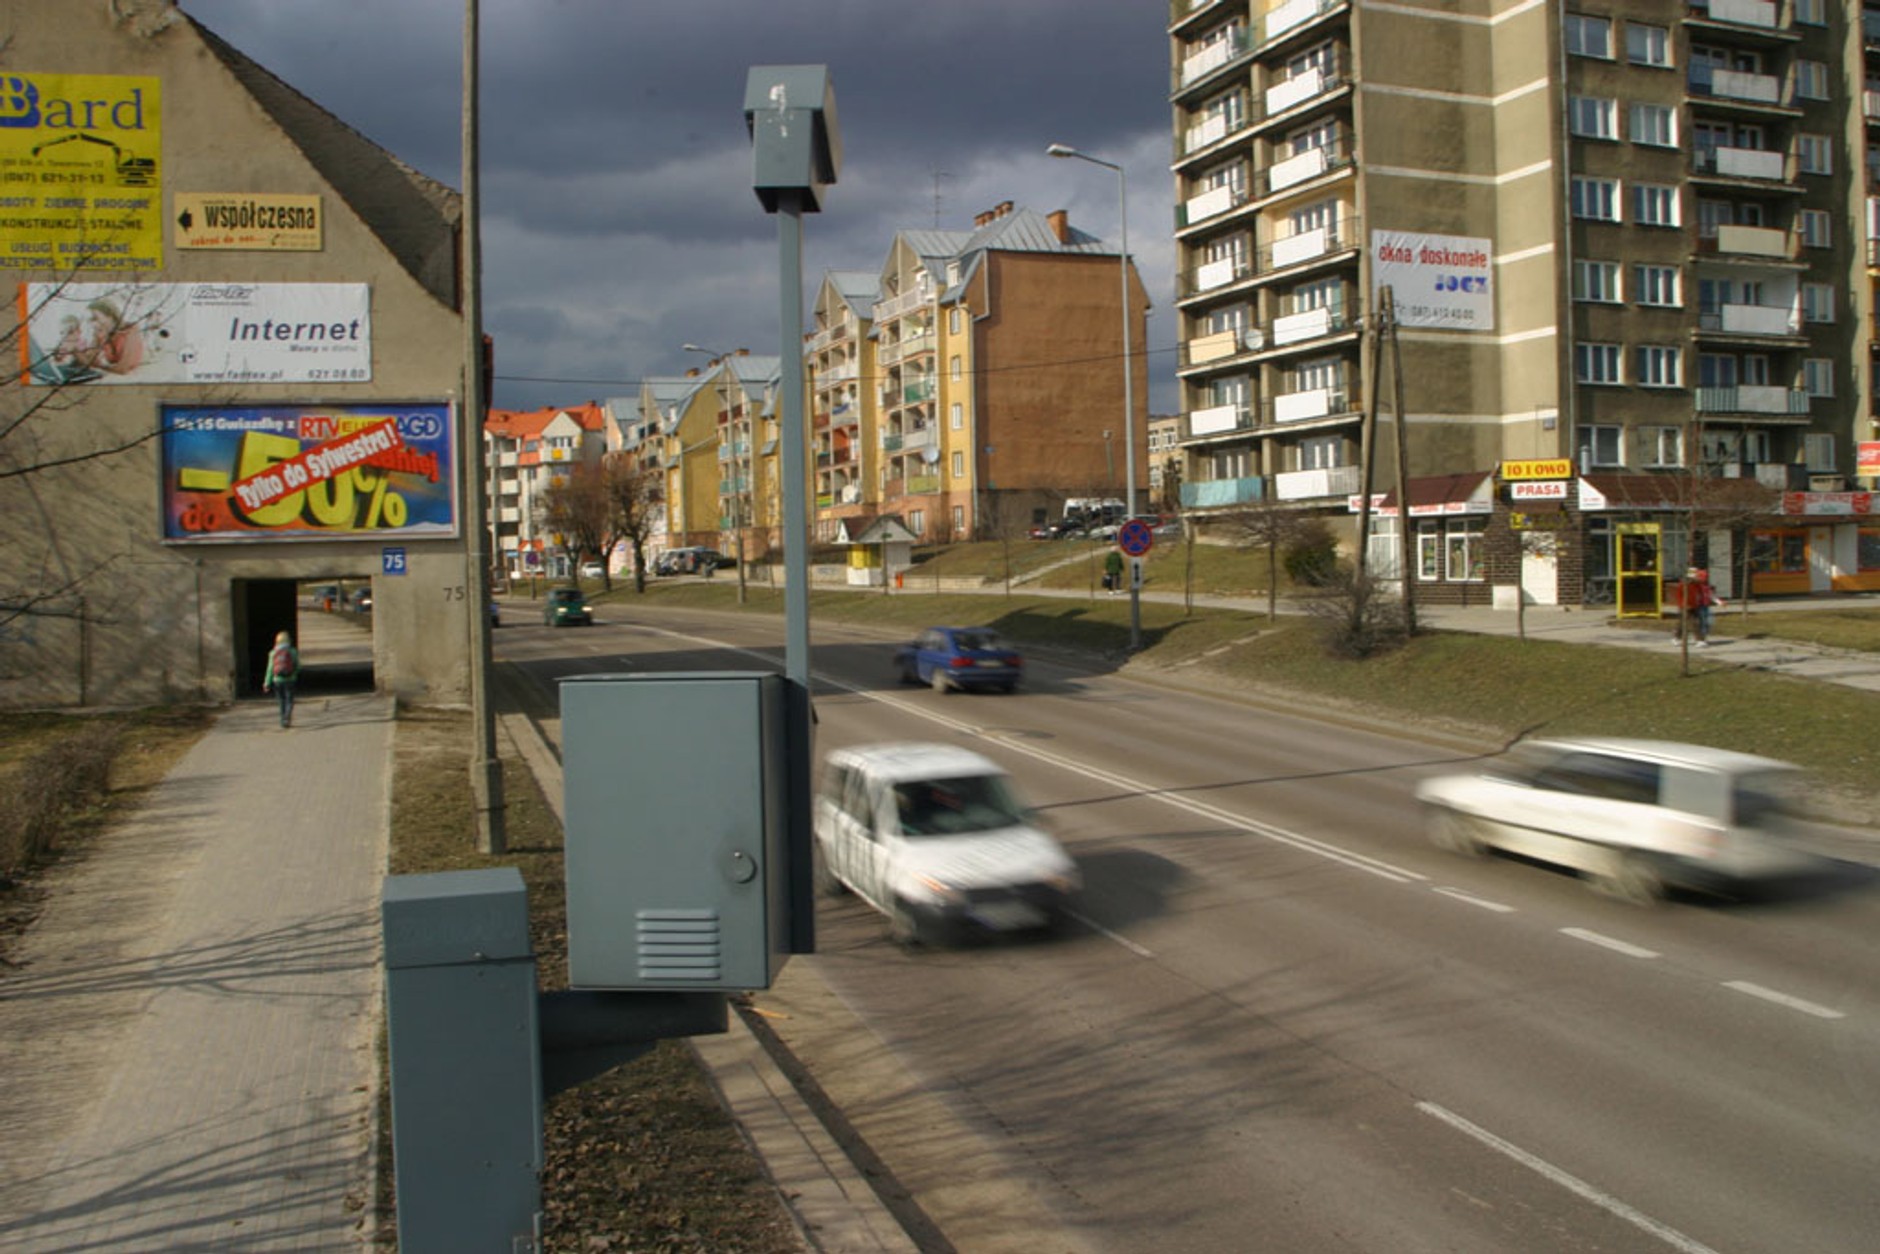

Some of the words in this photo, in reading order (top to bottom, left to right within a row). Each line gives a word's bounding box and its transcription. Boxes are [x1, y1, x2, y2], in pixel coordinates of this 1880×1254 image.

[205, 201, 316, 230] współczesna
[229, 317, 360, 341] Internet
[299, 416, 340, 439] RTV
[236, 475, 283, 508] Tylko
[283, 461, 308, 488] do
[1516, 484, 1561, 496] PRASA
[384, 555, 404, 569] 75
[443, 586, 465, 603] 75
